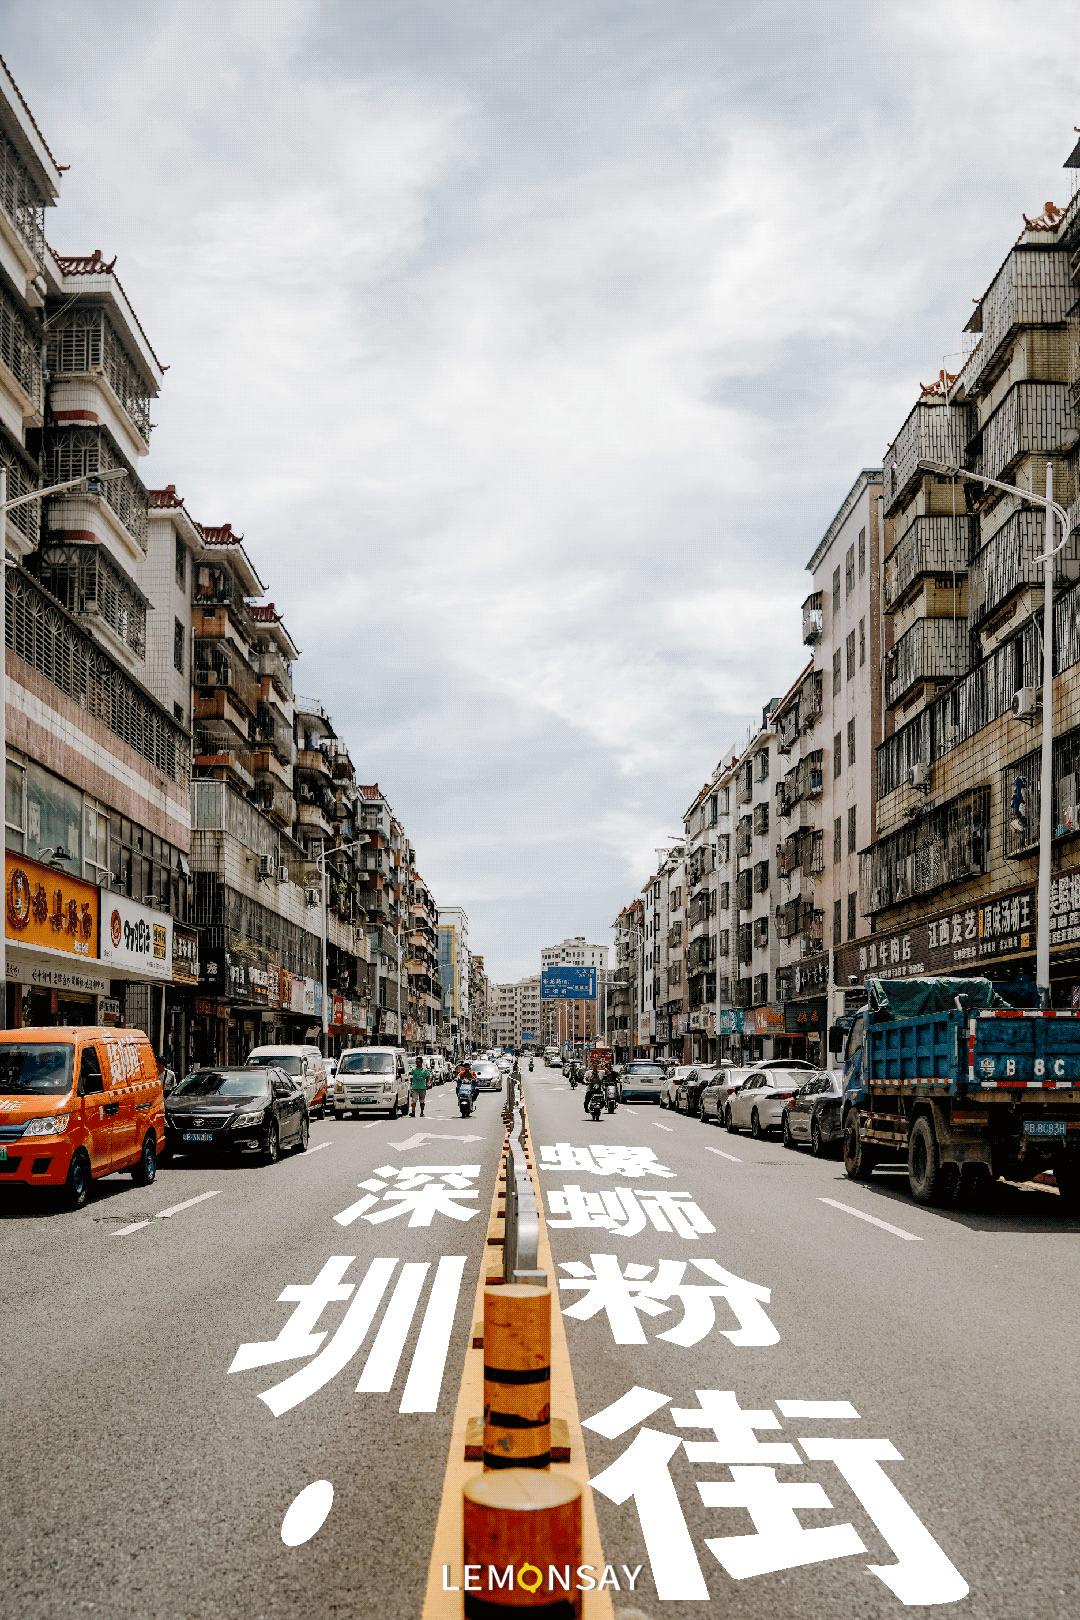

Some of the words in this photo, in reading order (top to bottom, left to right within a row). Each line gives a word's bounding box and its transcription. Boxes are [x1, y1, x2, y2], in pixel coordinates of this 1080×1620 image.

[984, 896, 1030, 938] 原味汤粉王
[859, 935, 911, 970] 潮汕牛肉店
